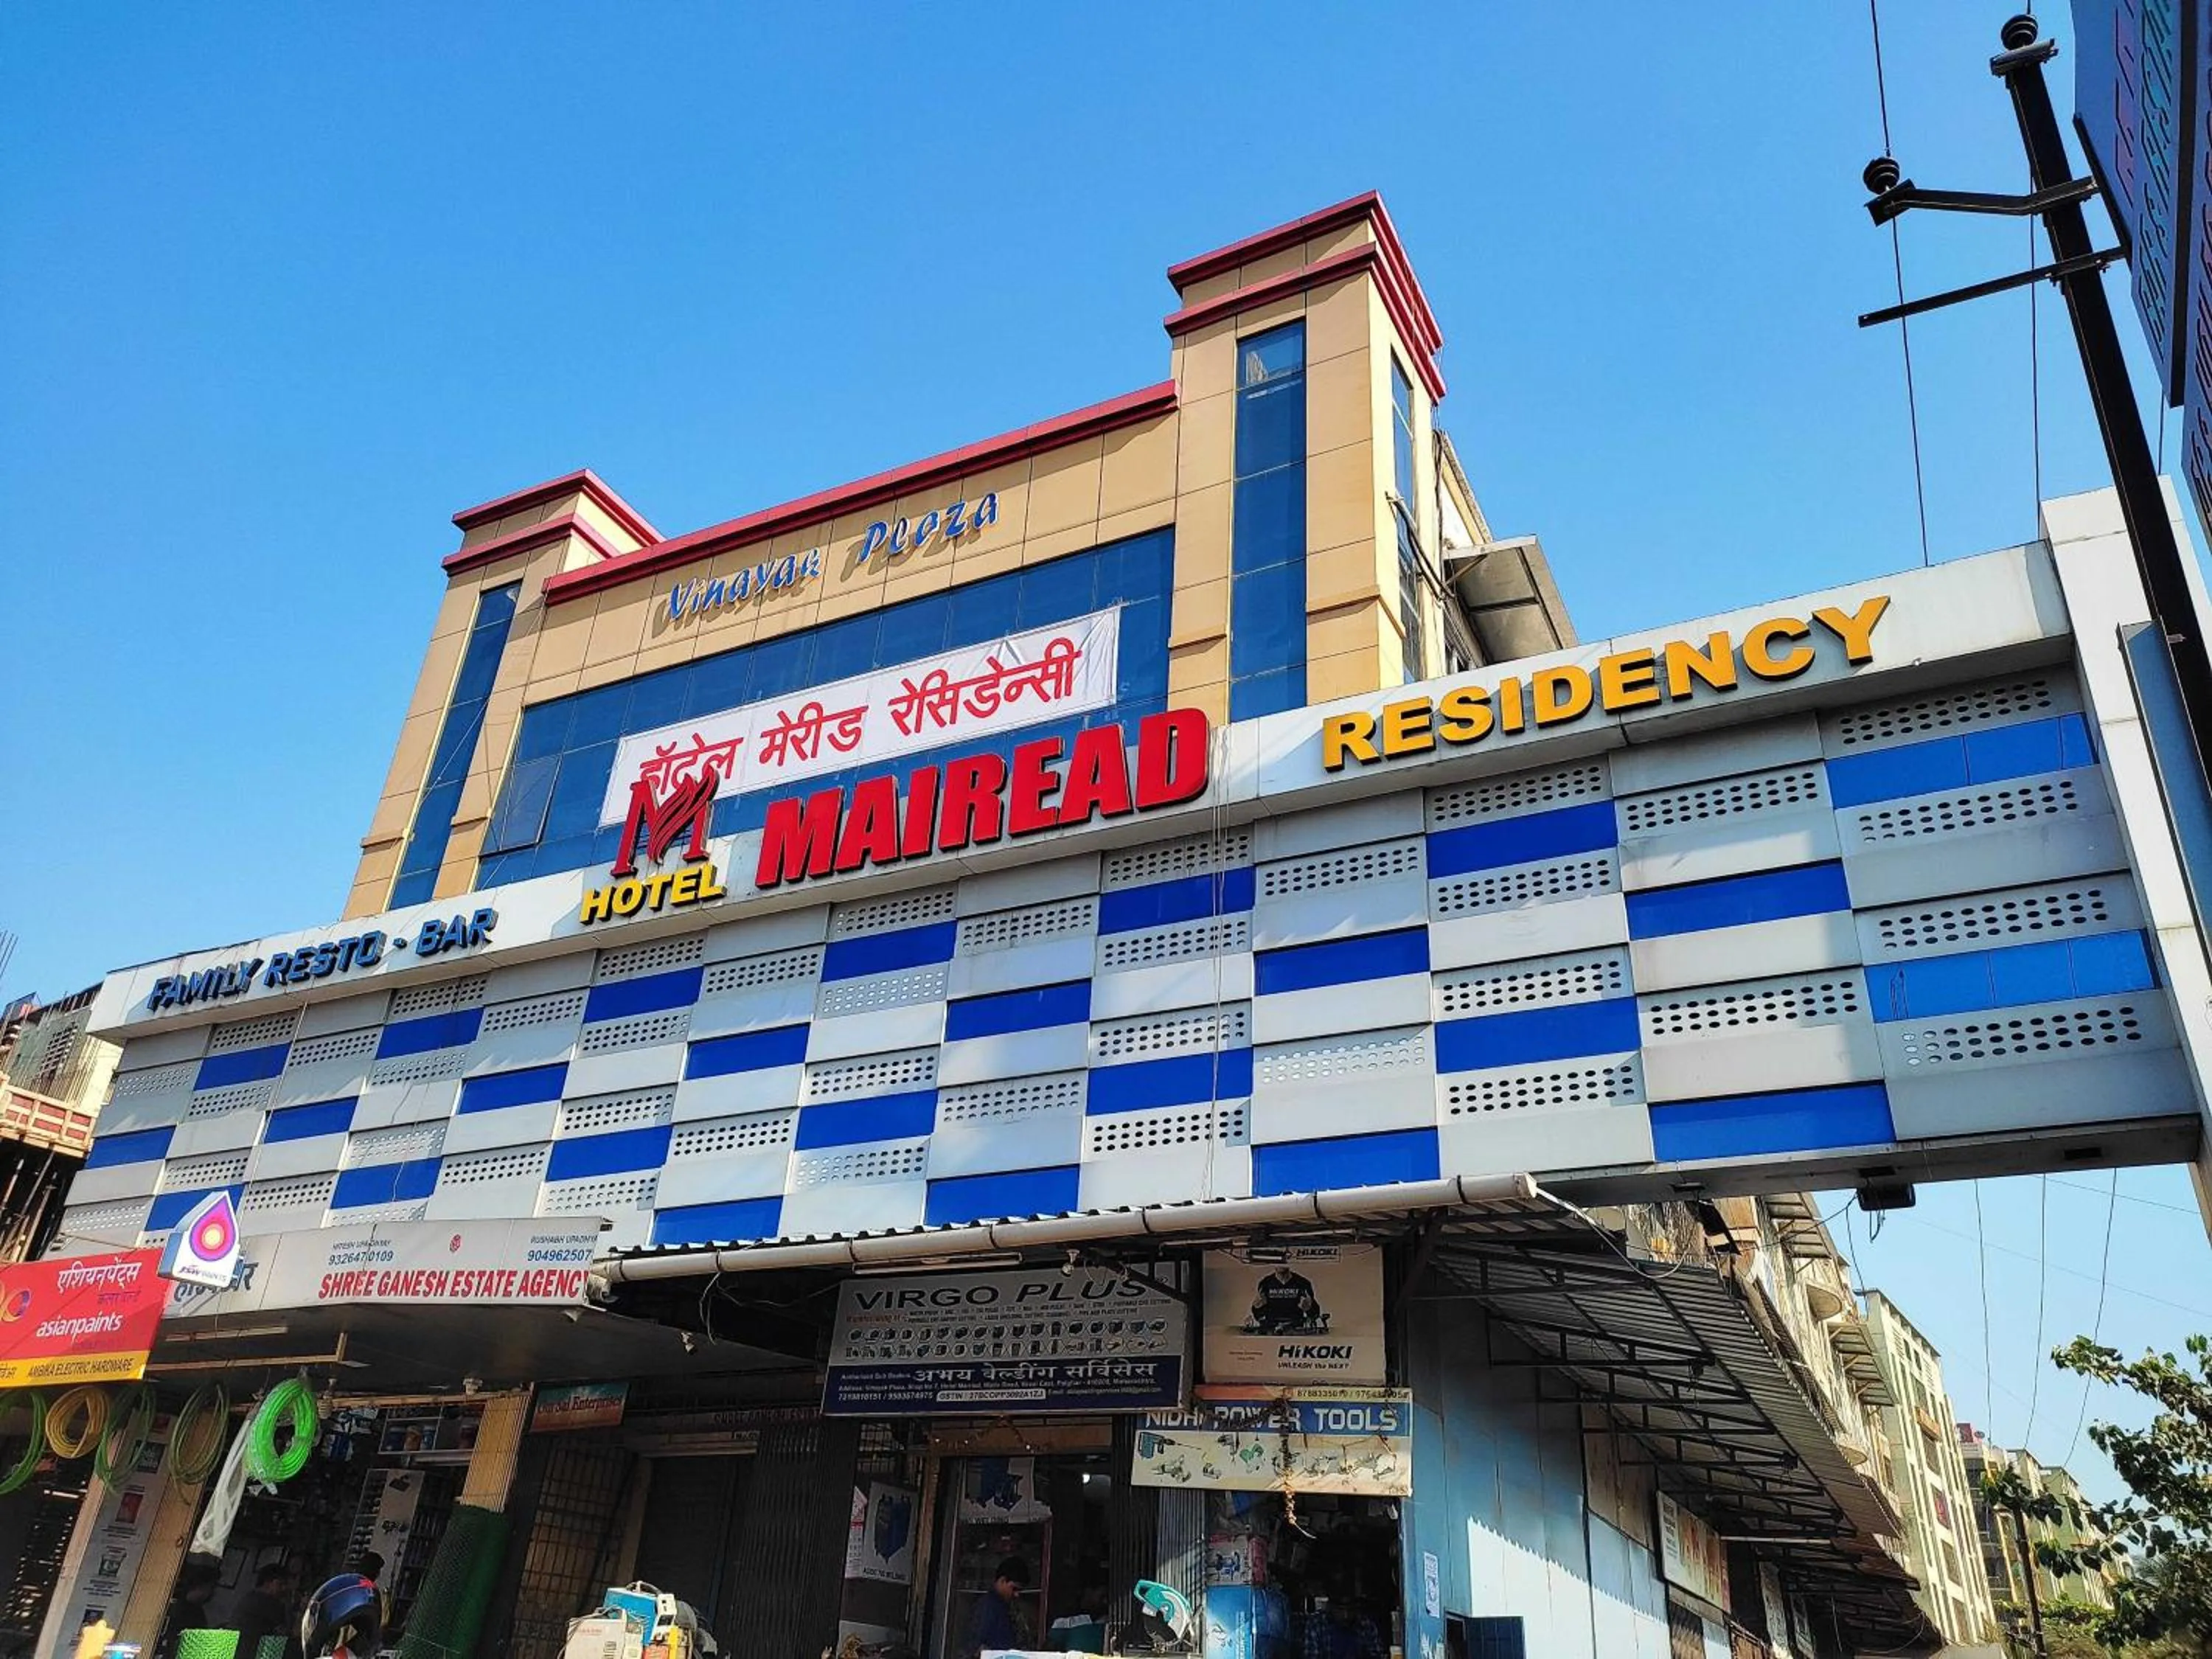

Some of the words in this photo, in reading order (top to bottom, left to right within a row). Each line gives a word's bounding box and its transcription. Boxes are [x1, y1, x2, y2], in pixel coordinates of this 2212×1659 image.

[1322, 594, 1891, 775] RESIDENCY
[759, 702, 869, 768] मेरीड
[889, 636, 1085, 736] रेसिडेन्सी
[754, 706, 1211, 889] MAIREAD
[579, 862, 727, 926] HOTEL
[147, 958, 264, 1012] FAMILY
[263, 930, 388, 988] RESTO
[415, 908, 498, 956] BAR
[329, 1250, 394, 1265] 9326470109
[527, 1249, 593, 1262] 904962507
[319, 1270, 378, 1299] SHREE
[378, 1270, 450, 1298] GANESH
[449, 1269, 518, 1298] ESTATE
[855, 1285, 1000, 1310] VIRGO
[1015, 1279, 1147, 1303] PLUS
[914, 1368, 976, 1382] अभय
[1064, 1358, 1157, 1378] सर्विसेस
[1214, 1406, 1301, 1431] POWER
[1314, 1408, 1399, 1432] TOOLS
